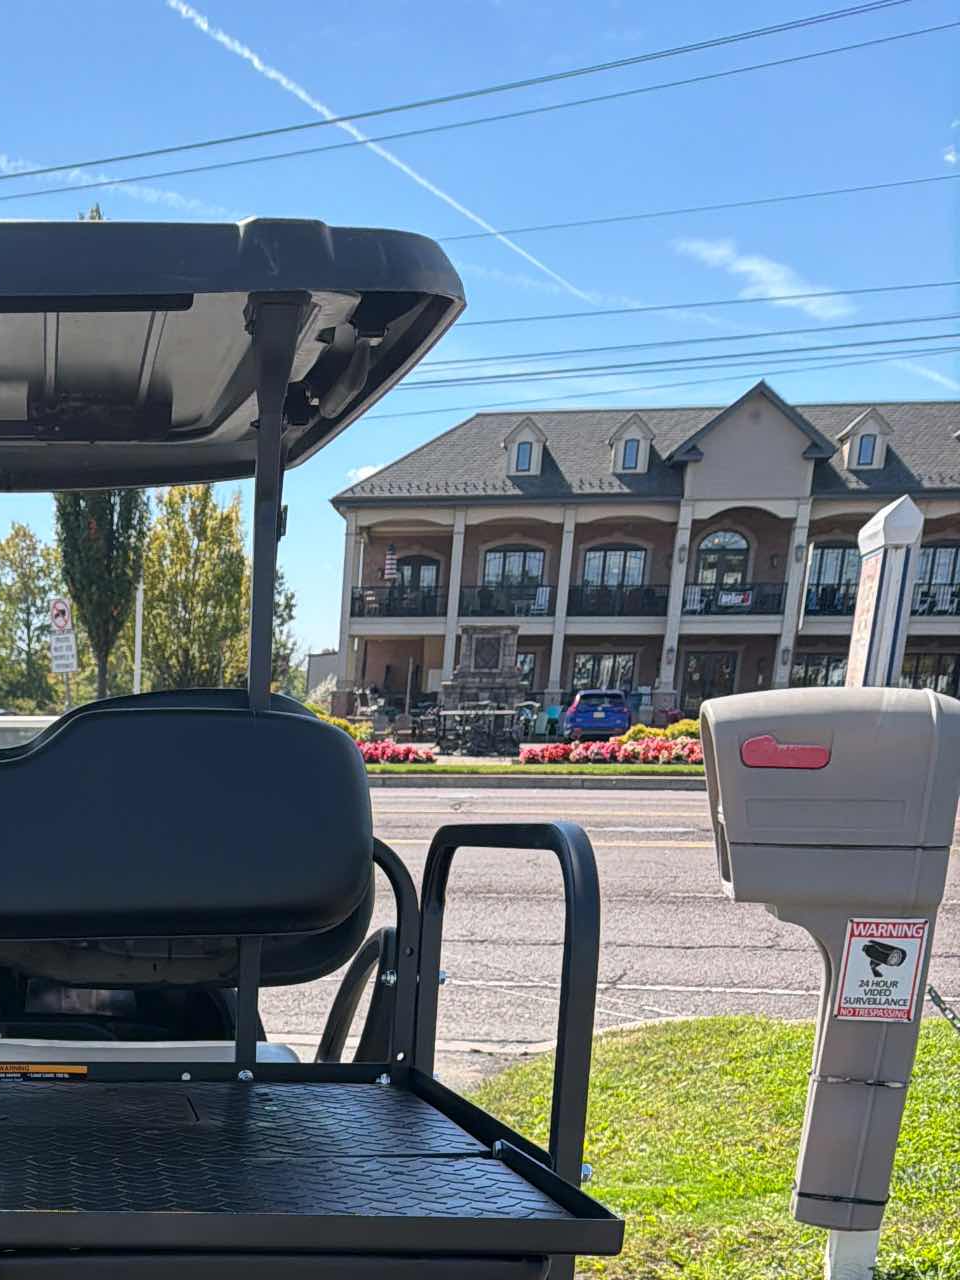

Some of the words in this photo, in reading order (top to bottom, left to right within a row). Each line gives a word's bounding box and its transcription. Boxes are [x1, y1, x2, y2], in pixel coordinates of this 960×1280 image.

[852, 923, 924, 937] WARNING
[858, 980, 870, 988] 24
[871, 980, 899, 988] HOUR
[863, 989, 892, 997] VIDEO
[843, 996, 908, 1007] SURVEILLANCE
[840, 1008, 854, 1016] NO
[854, 1008, 908, 1018] TRESPASSING
